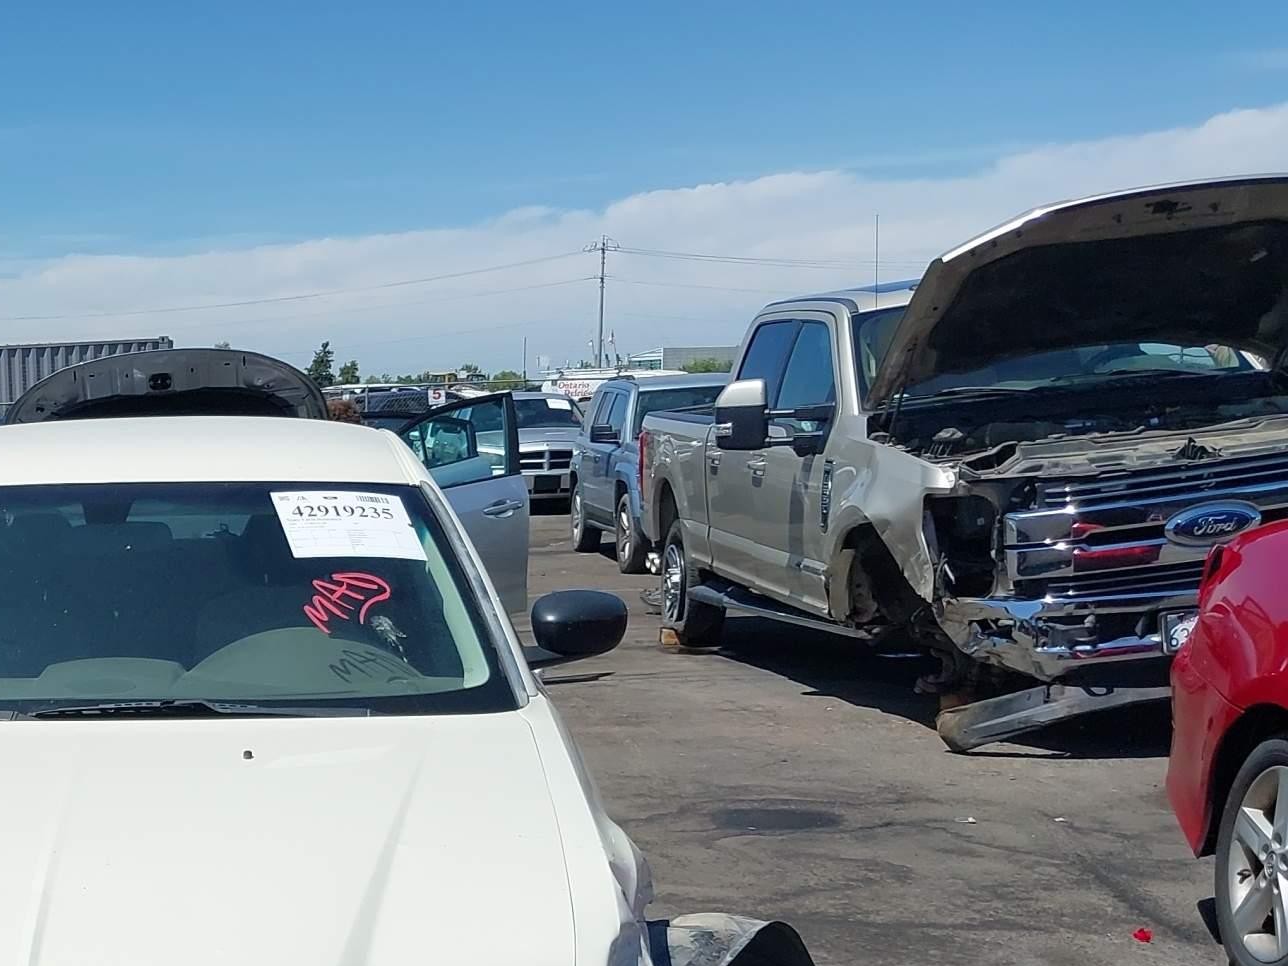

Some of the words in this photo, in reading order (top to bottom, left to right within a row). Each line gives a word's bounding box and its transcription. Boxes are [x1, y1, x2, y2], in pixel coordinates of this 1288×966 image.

[558, 381, 590, 389] Ontario
[432, 388, 442, 400] 5
[292, 504, 394, 520] 42919235
[1193, 515, 1238, 536] Ford
[303, 572, 391, 634] MAD
